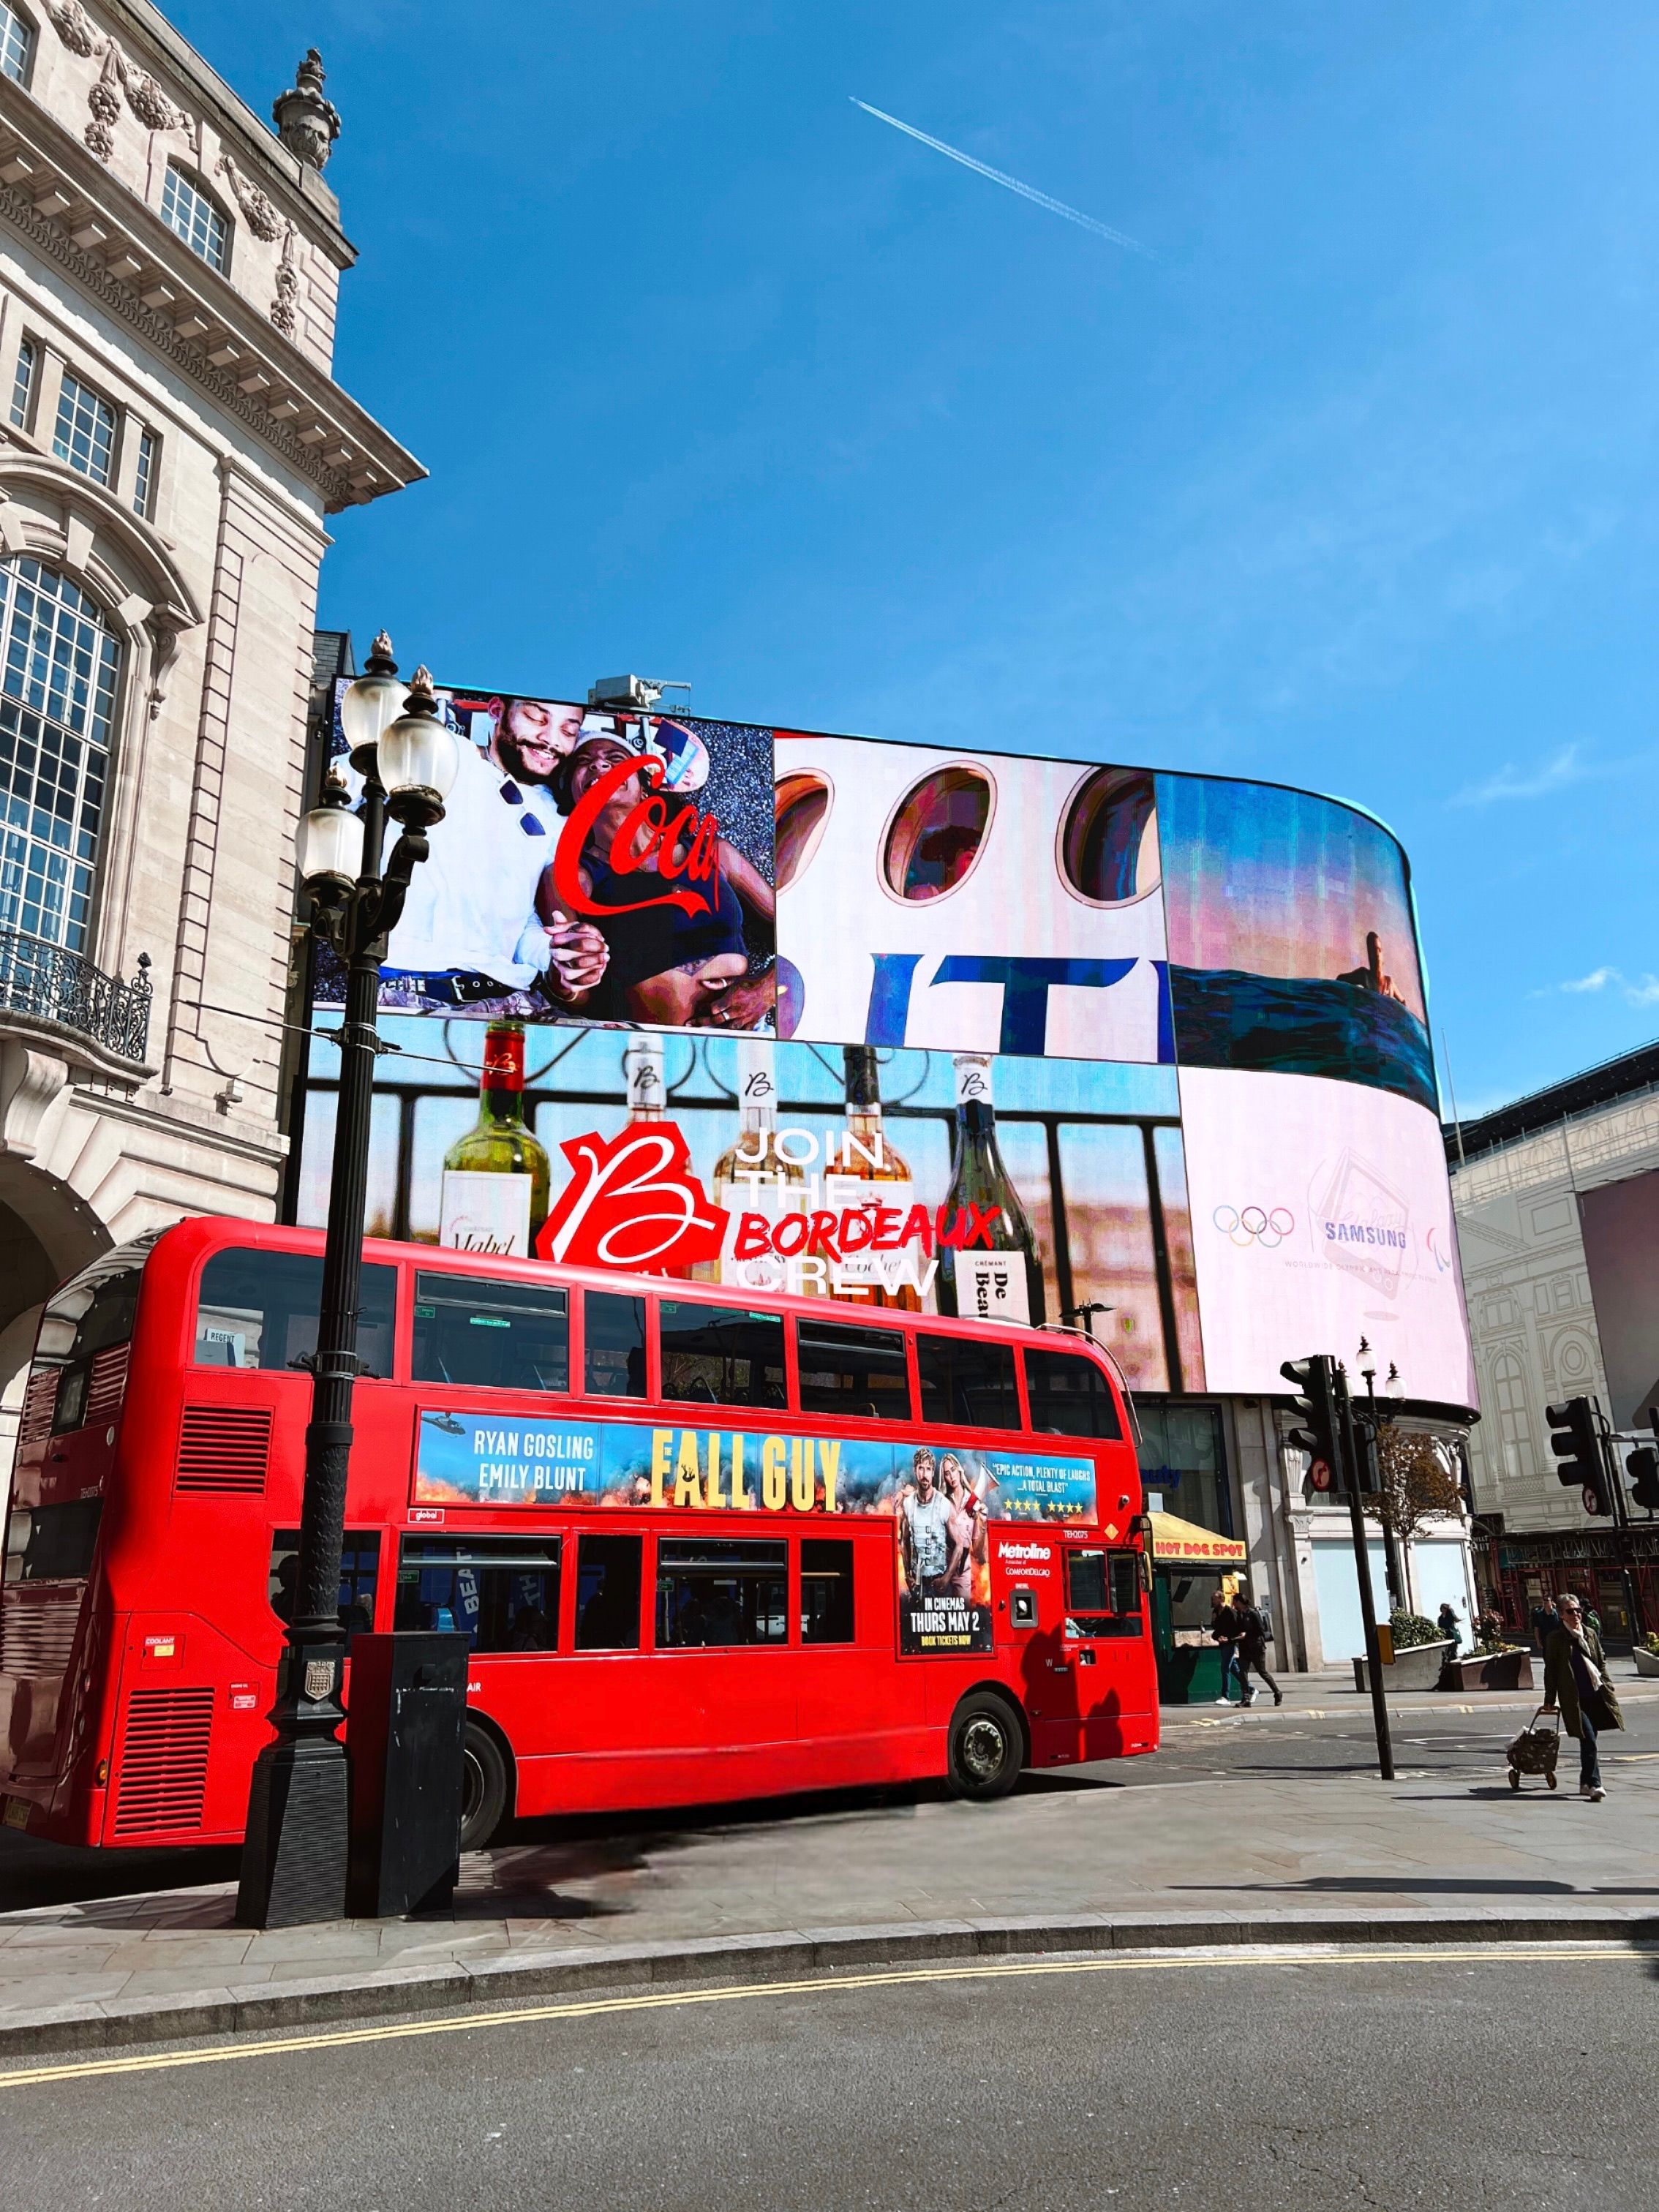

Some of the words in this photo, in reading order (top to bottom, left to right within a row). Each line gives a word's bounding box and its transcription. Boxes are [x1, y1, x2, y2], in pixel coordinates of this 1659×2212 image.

[734, 1127, 884, 1168] JOIN
[734, 1170, 862, 1209] THE
[734, 1202, 1002, 1264] BORDEAUX
[1325, 1222, 1407, 1249] SAMSUNG
[735, 1256, 939, 1296] CREW
[994, 1272, 1008, 1300] De
[211, 1332, 235, 1343] REGENT
[474, 1430, 519, 1456] RYAN
[524, 1433, 593, 1460] GOSLING
[479, 1463, 530, 1489] EMILY
[534, 1465, 587, 1491] BLUNT
[651, 1429, 750, 1508] FALL
[763, 1437, 841, 1511] GUY
[415, 1511, 437, 1521] global
[998, 1541, 1050, 1560] Metroline
[1156, 1542, 1181, 1555] HOT
[1184, 1543, 1210, 1555] DOG
[1212, 1544, 1243, 1557] SPOT
[925, 1598, 933, 1611] IN
[934, 1598, 965, 1611] CINEMAS
[911, 1612, 946, 1633] THURS
[948, 1611, 970, 1632] MAY
[971, 1611, 980, 1631] 2
[922, 1636, 936, 1646] BOOK
[937, 1636, 958, 1646] TICKETS
[467, 1682, 481, 1693] AIR
